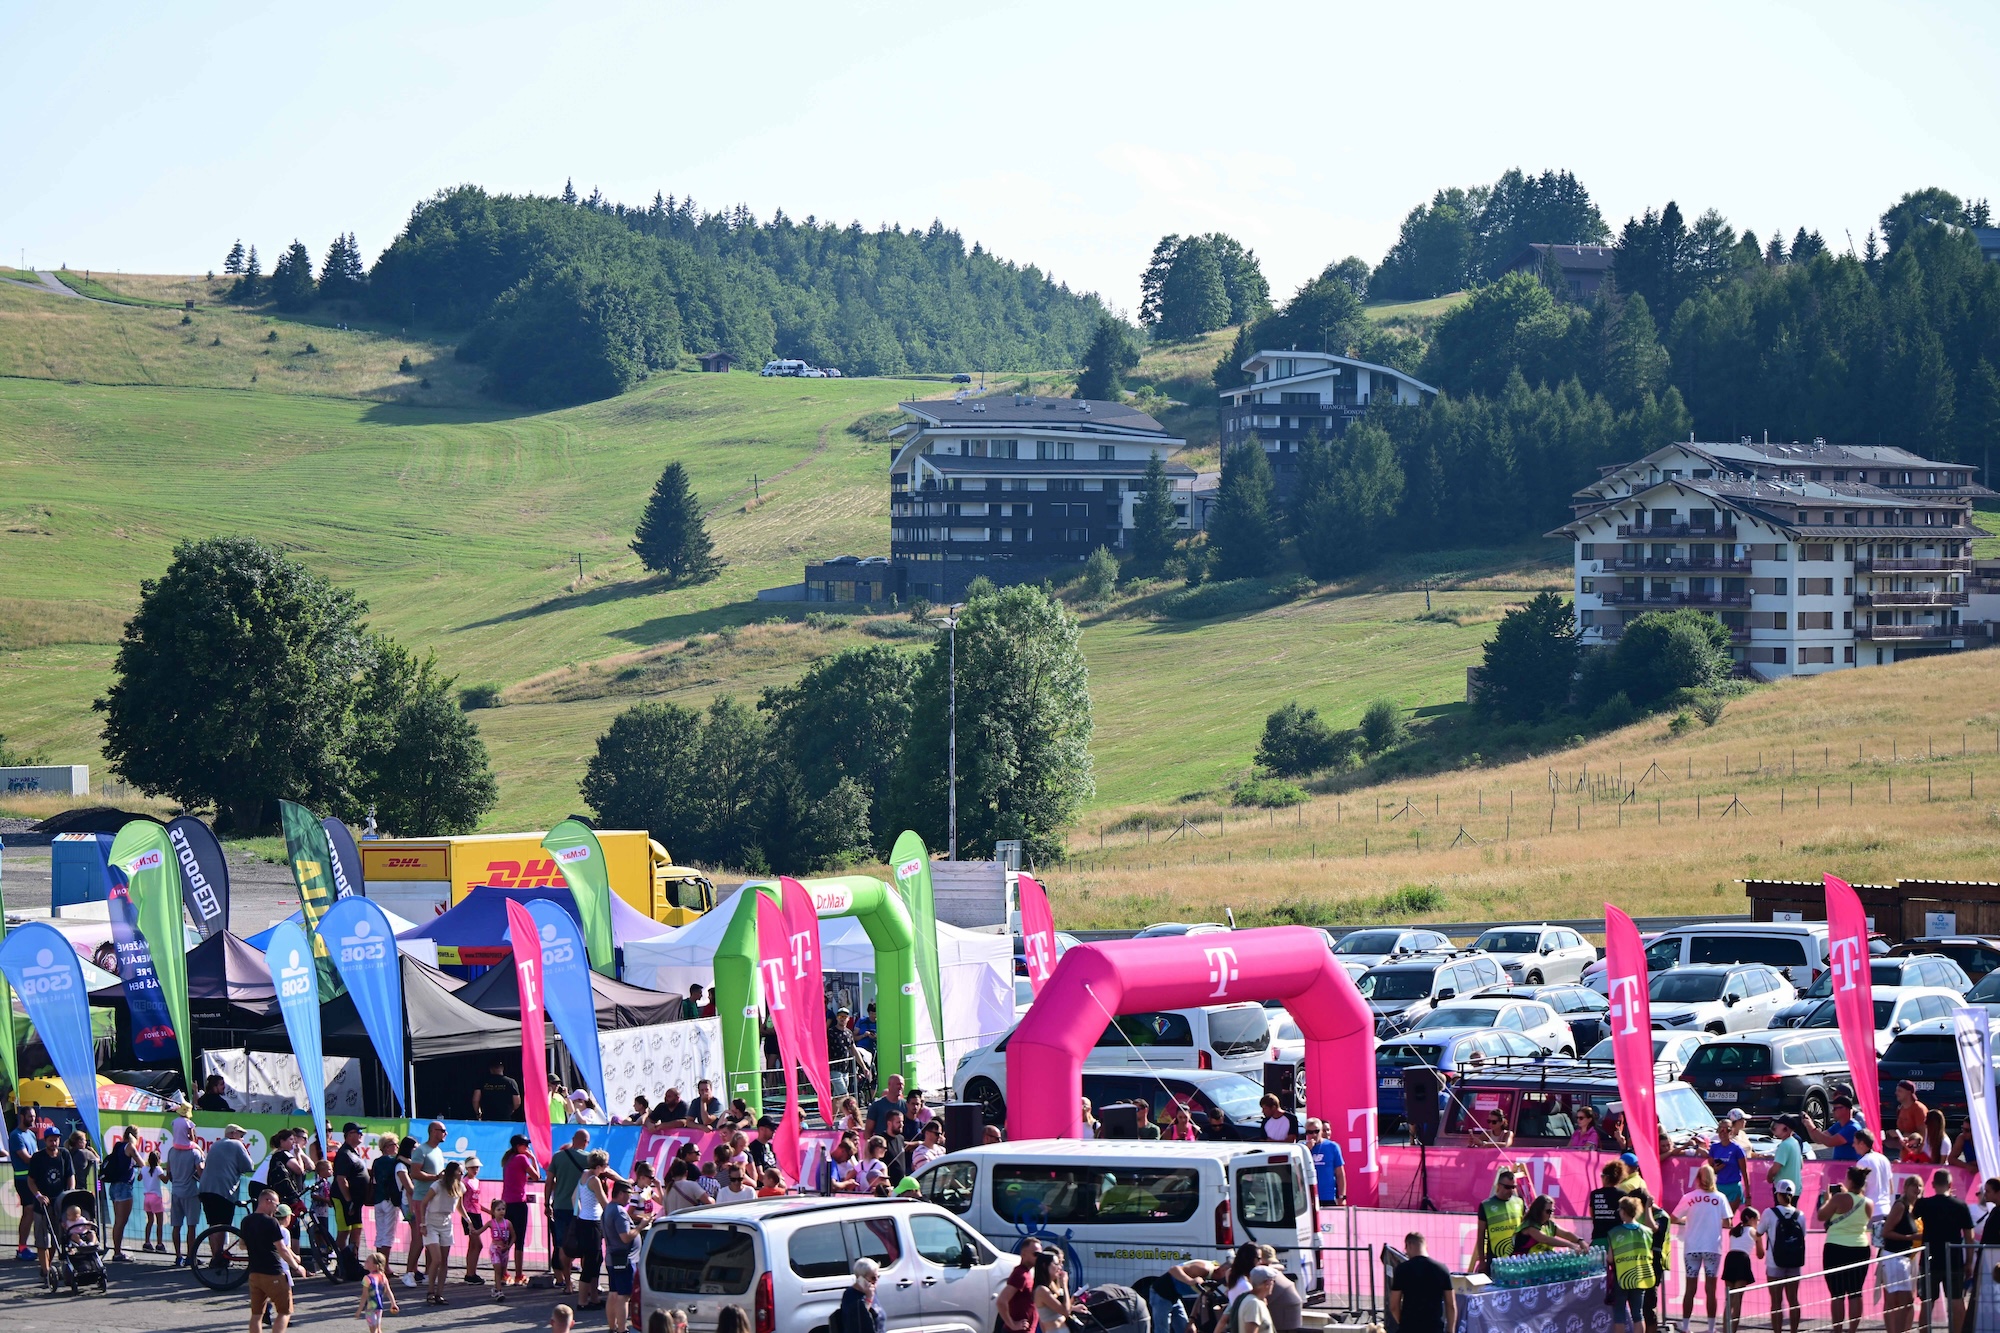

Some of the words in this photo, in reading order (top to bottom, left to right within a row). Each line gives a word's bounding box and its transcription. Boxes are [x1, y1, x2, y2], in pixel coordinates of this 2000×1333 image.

[388, 858, 422, 867] DHL
[816, 893, 845, 910] Dr.Max
[1026, 931, 1050, 981] T
[1203, 947, 1239, 998] T
[1832, 935, 1860, 992] T
[519, 959, 546, 1013] T
[762, 957, 787, 1011] T
[1609, 974, 1640, 1036] T
[1688, 1195, 1719, 1207] HUGO
